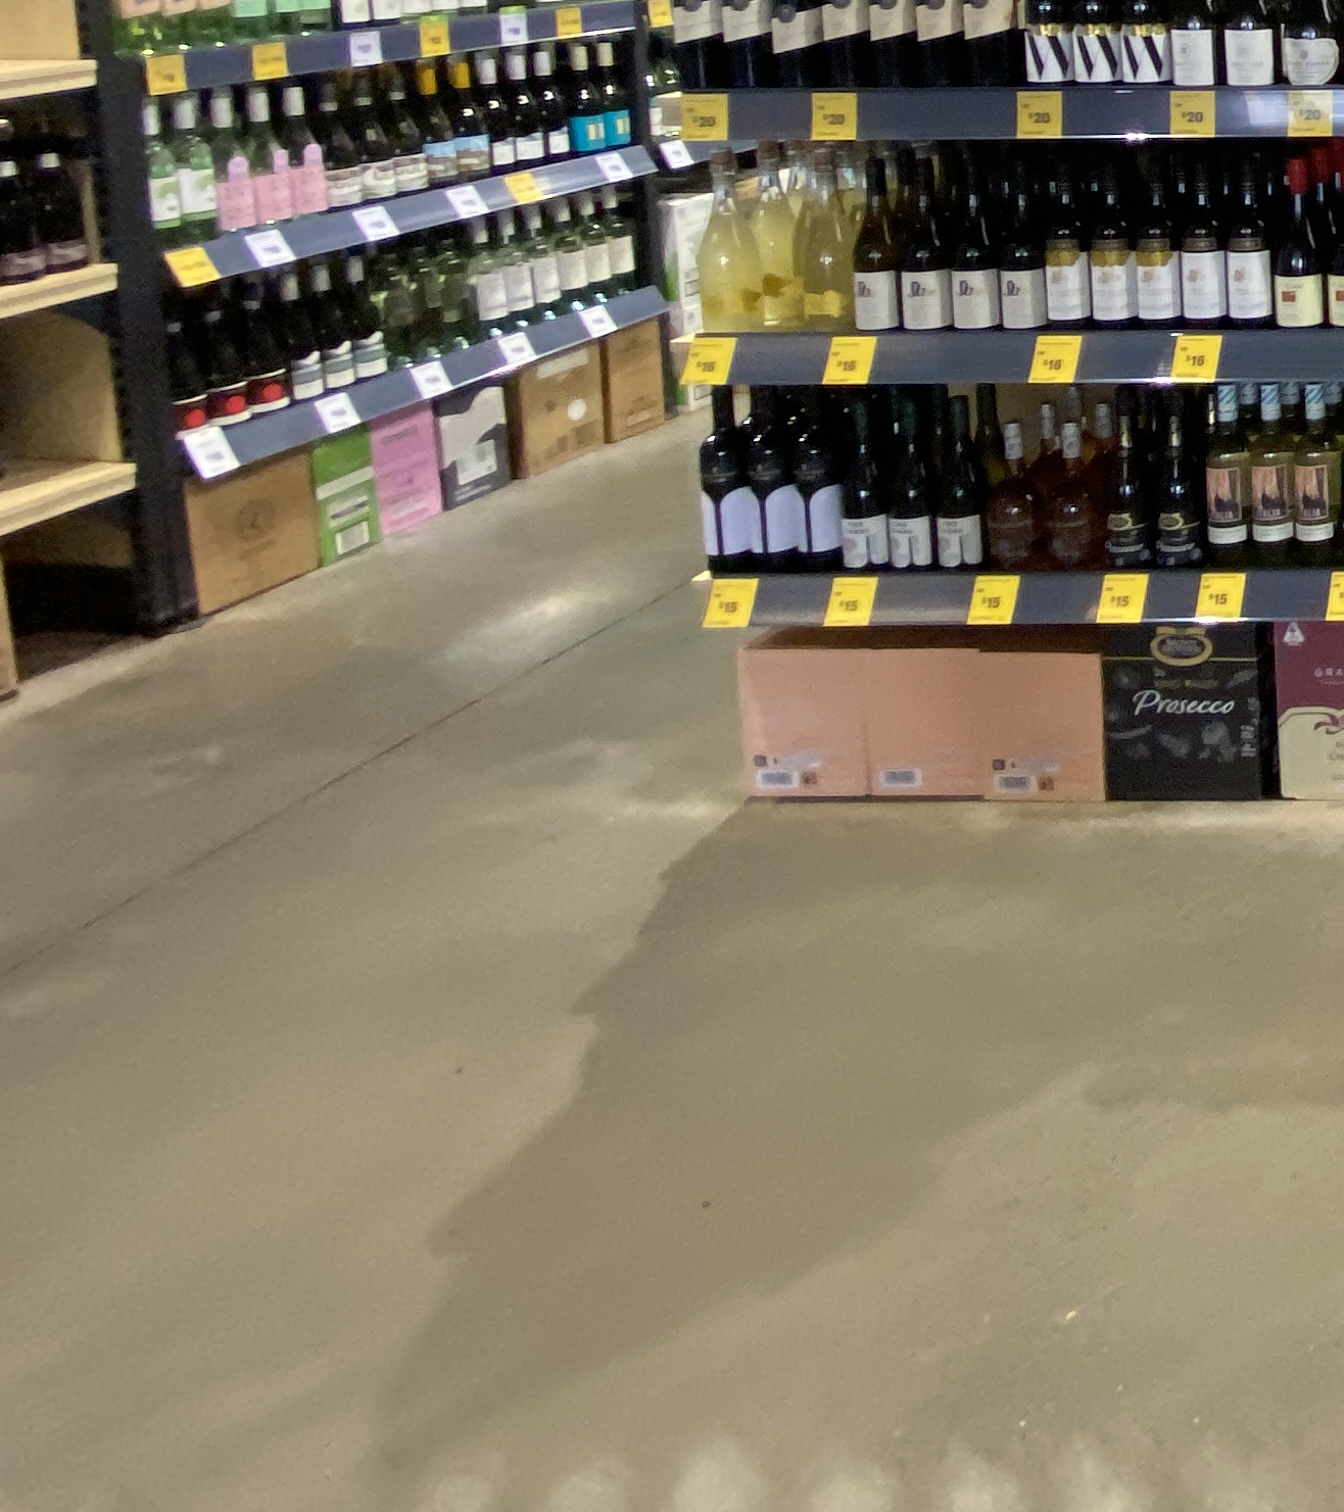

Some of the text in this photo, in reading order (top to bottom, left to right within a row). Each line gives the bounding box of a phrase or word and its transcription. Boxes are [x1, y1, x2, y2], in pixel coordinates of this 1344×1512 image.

[692, 114, 716, 128] $20
[822, 113, 846, 126] $20
[1028, 111, 1051, 125] $20
[1181, 110, 1204, 124] $20
[1299, 107, 1321, 121] $20
[838, 599, 859, 612] $15
[981, 596, 1001, 609] $15
[1110, 595, 1129, 608] $15
[1208, 592, 1229, 606] $15
[719, 600, 738, 614] $15
[1132, 688, 1236, 717] Prosecco
